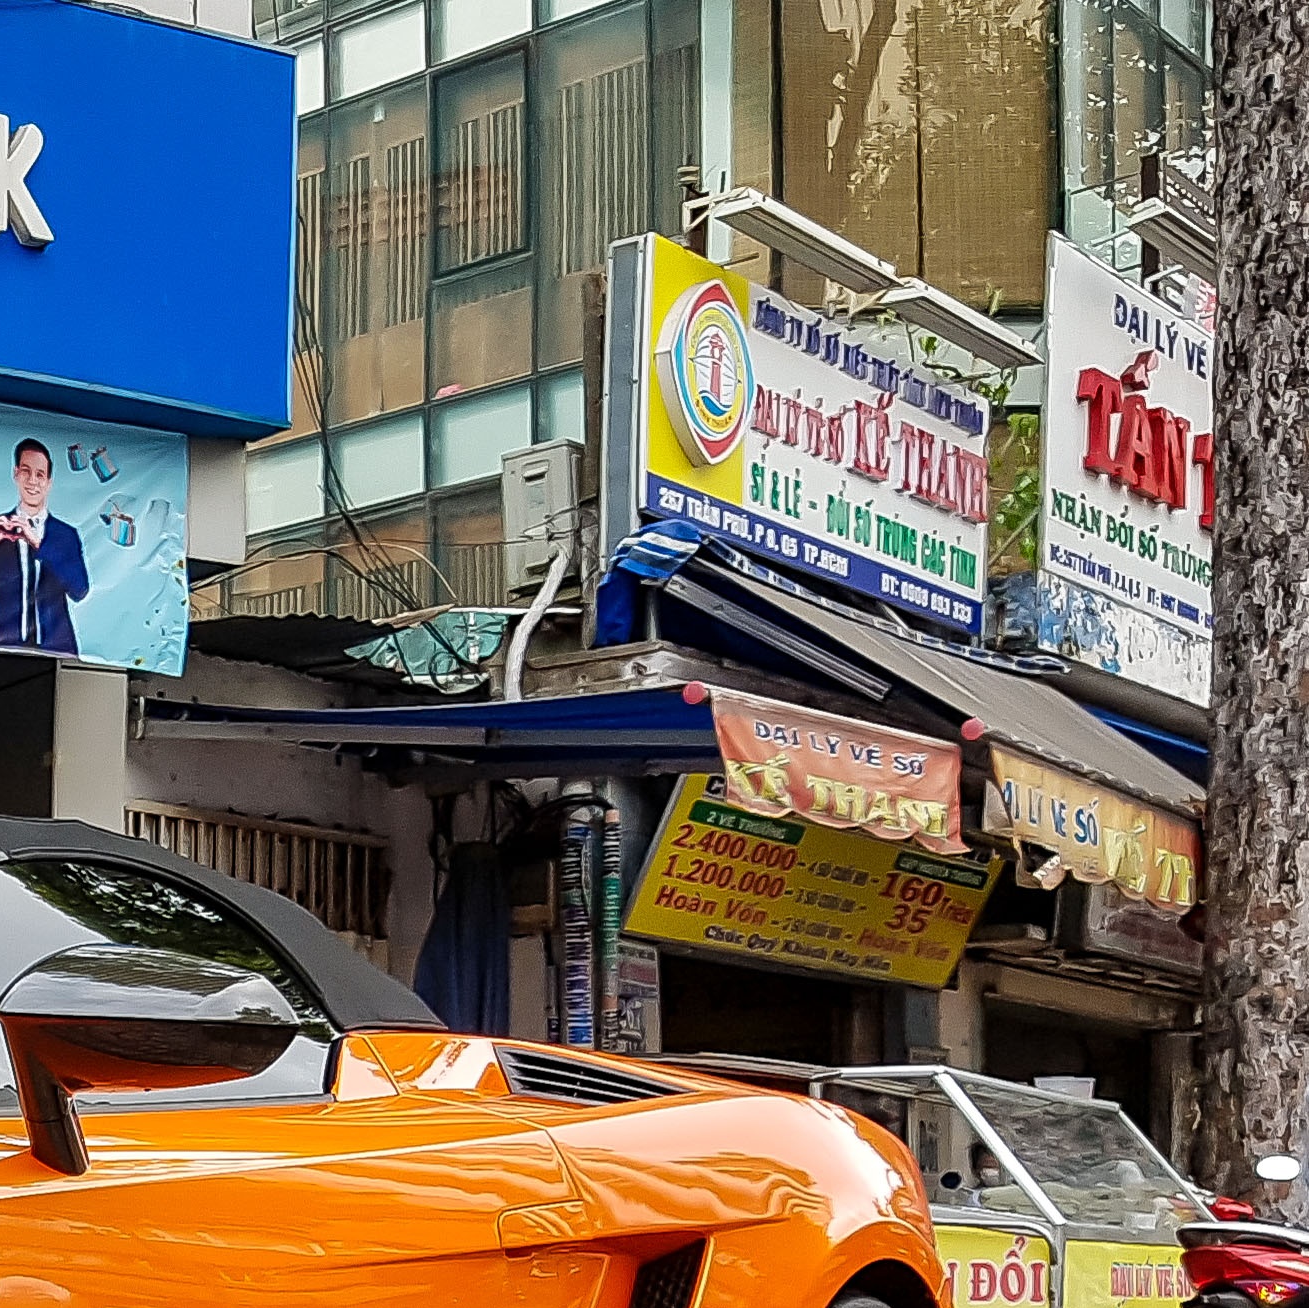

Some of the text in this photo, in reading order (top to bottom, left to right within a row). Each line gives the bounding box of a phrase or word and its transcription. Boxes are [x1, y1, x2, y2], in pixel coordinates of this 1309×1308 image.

[1114, 293, 1207, 380] ĐẠI LÝ VÉ
[1051, 487, 1102, 540] NHẬN
[654, 884, 718, 916] Hoàn
[661, 853, 786, 899] 1.200.000
[884, 903, 933, 934] 35
[670, 823, 799, 872] 2.400.000
[879, 872, 946, 907] 160
[968, 1235, 1045, 1302] ĐỔI
